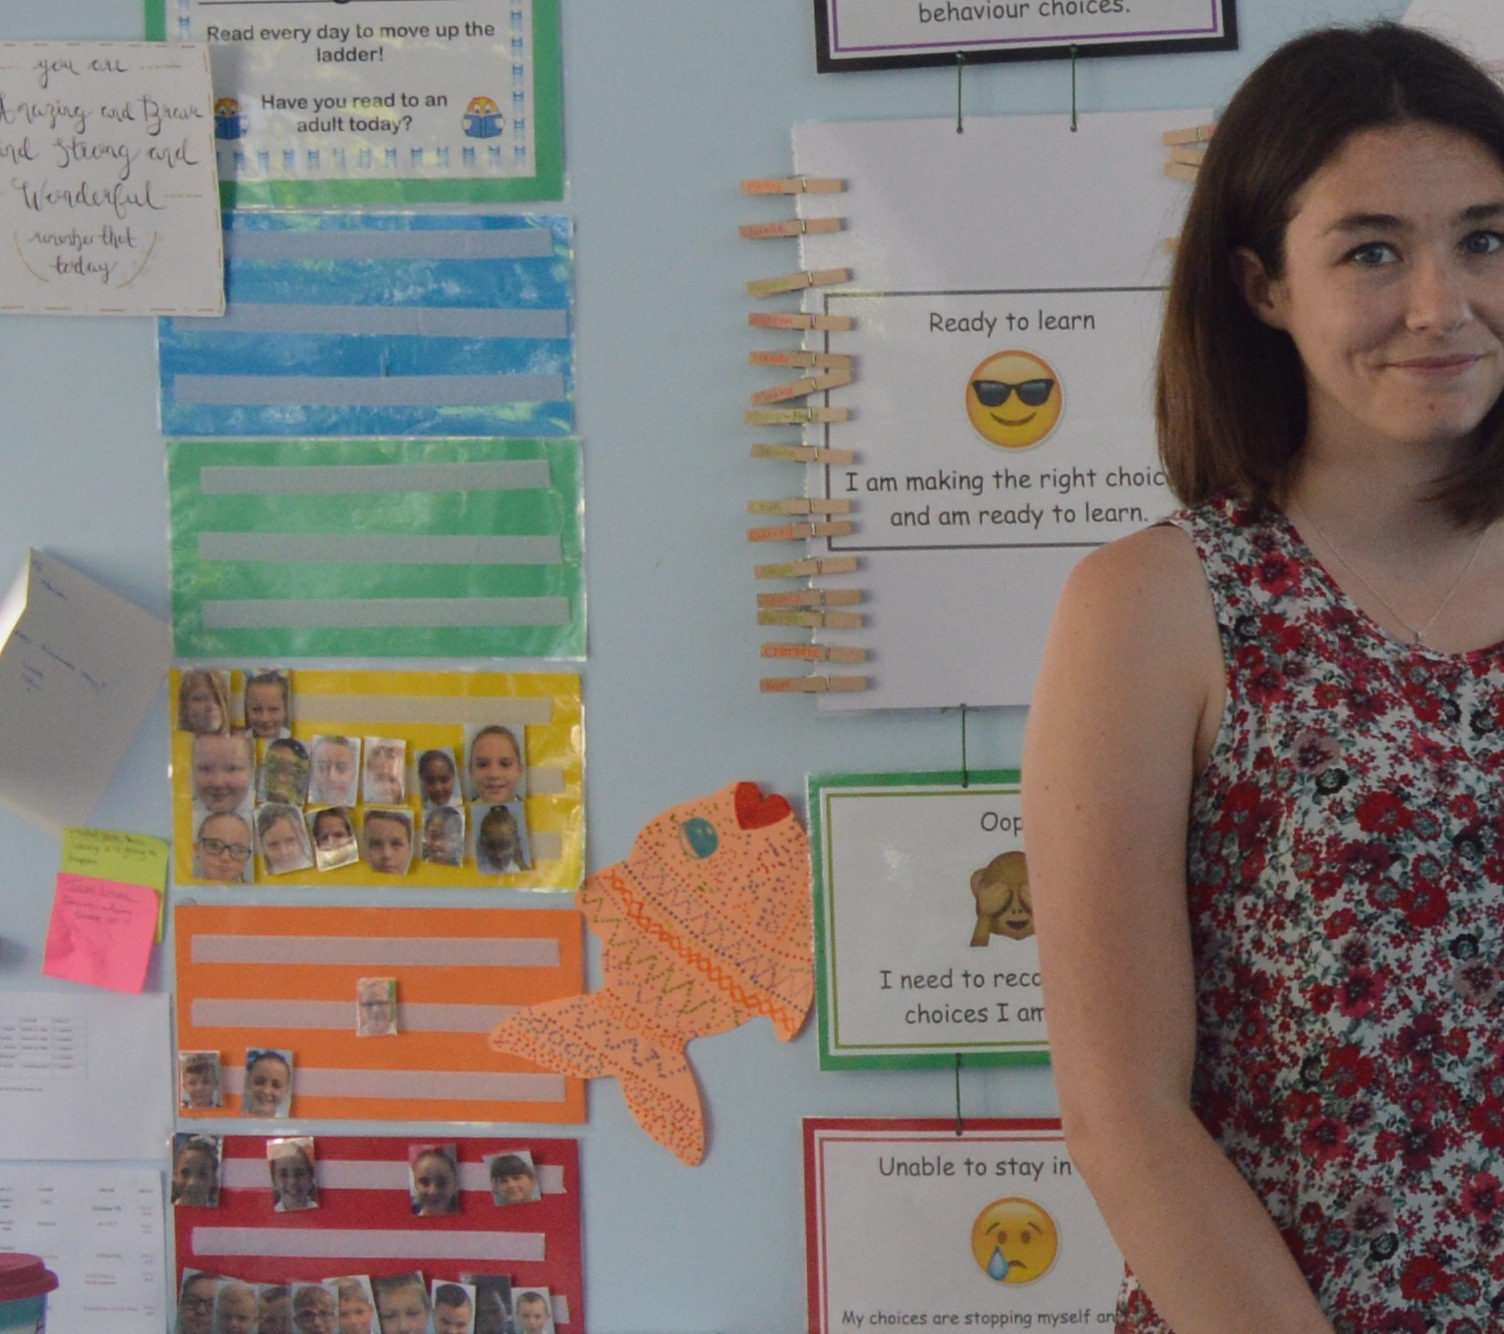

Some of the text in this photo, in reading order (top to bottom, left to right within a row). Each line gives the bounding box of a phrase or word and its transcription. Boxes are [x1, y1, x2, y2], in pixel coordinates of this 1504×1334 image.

[918, 0, 1030, 23] behaviour
[207, 20, 495, 46] Read every day to move up the
[316, 45, 384, 63] ladder!
[262, 92, 448, 114] Have you read to an
[297, 114, 412, 135] adult today?
[929, 310, 1096, 337] Ready to learn
[846, 471, 858, 492] I
[866, 475, 898, 493] am
[906, 470, 984, 495] making
[992, 469, 1031, 491] the
[1040, 468, 1097, 495] right
[890, 503, 1149, 530] and am ready to learn.
[879, 1155, 1072, 1181] Unable to stay in
